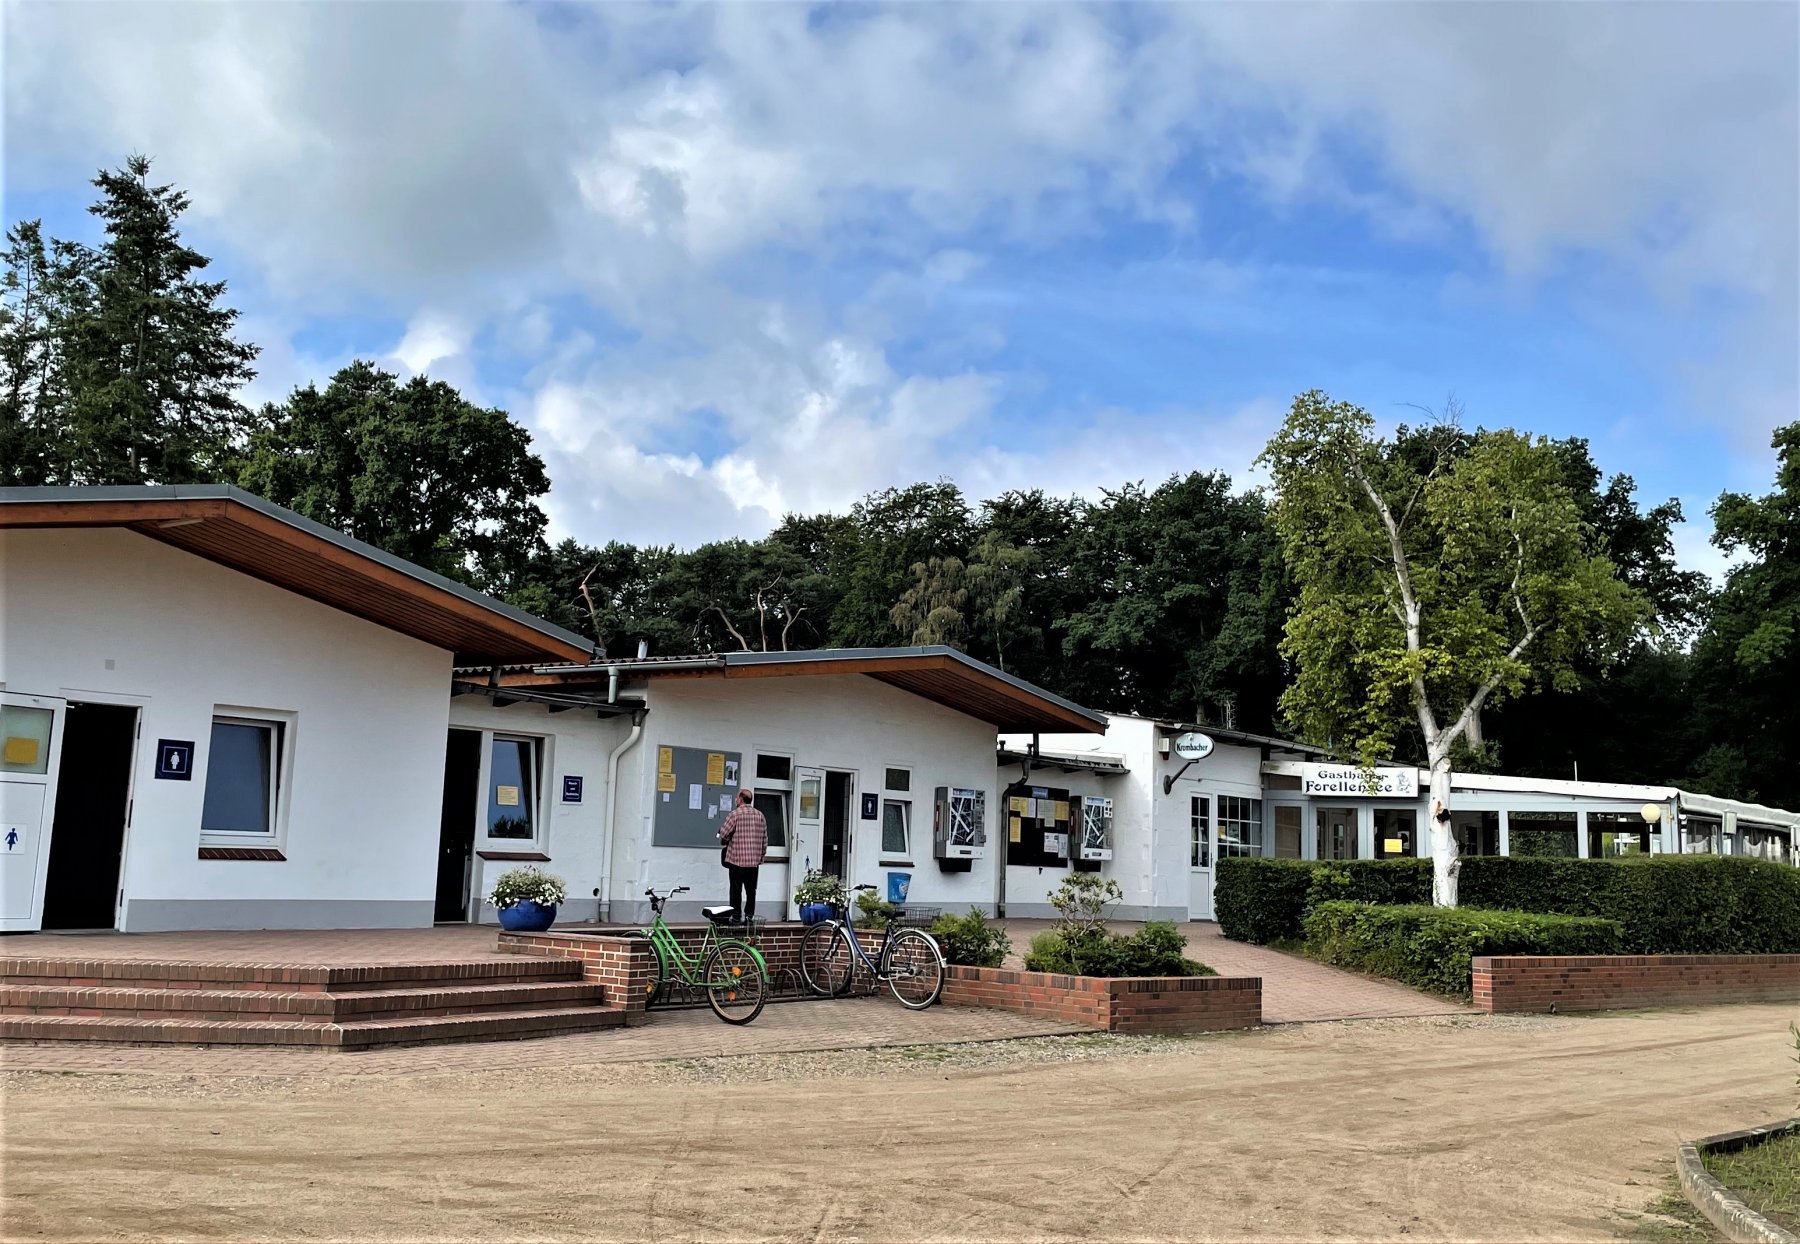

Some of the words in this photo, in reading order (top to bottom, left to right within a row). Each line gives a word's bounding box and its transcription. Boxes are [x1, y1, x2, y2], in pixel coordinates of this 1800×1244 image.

[1176, 742, 1209, 752] Krombacher
[1318, 770, 1380, 781] Gastha
[1305, 780, 1393, 794] Forellenee
